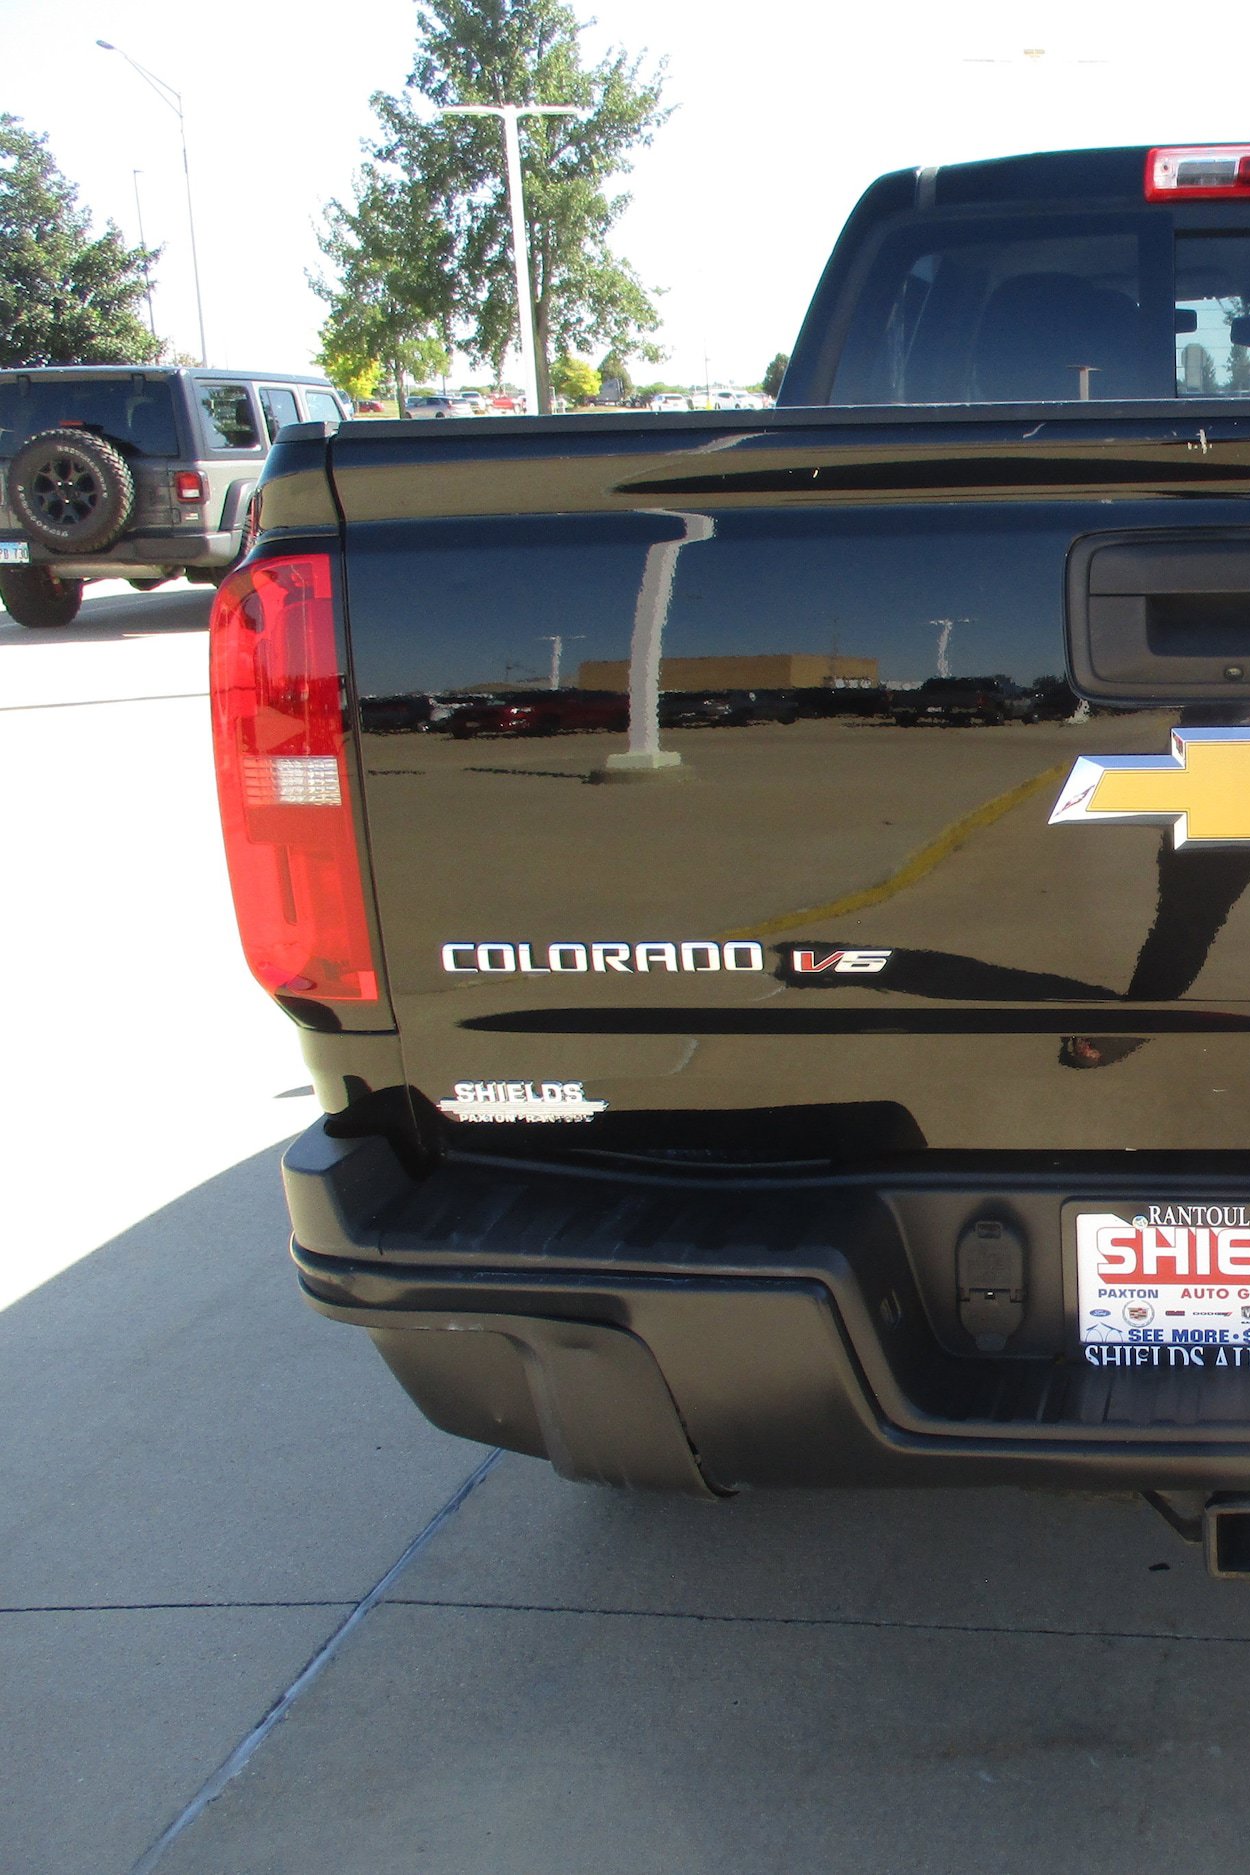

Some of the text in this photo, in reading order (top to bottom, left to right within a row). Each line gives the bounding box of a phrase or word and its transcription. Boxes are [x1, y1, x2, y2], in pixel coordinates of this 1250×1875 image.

[441, 940, 894, 974] COLORADO V6
[454, 1081, 583, 1103] SHIELDS
[459, 1113, 515, 1123] PAXTON
[1148, 1206, 1250, 1227] RANTOUL
[1098, 1288, 1158, 1299] PAXTON
[1181, 1288, 1229, 1300] AUTO
[1128, 1328, 1164, 1342] SEE
[1172, 1329, 1229, 1343] MORE
